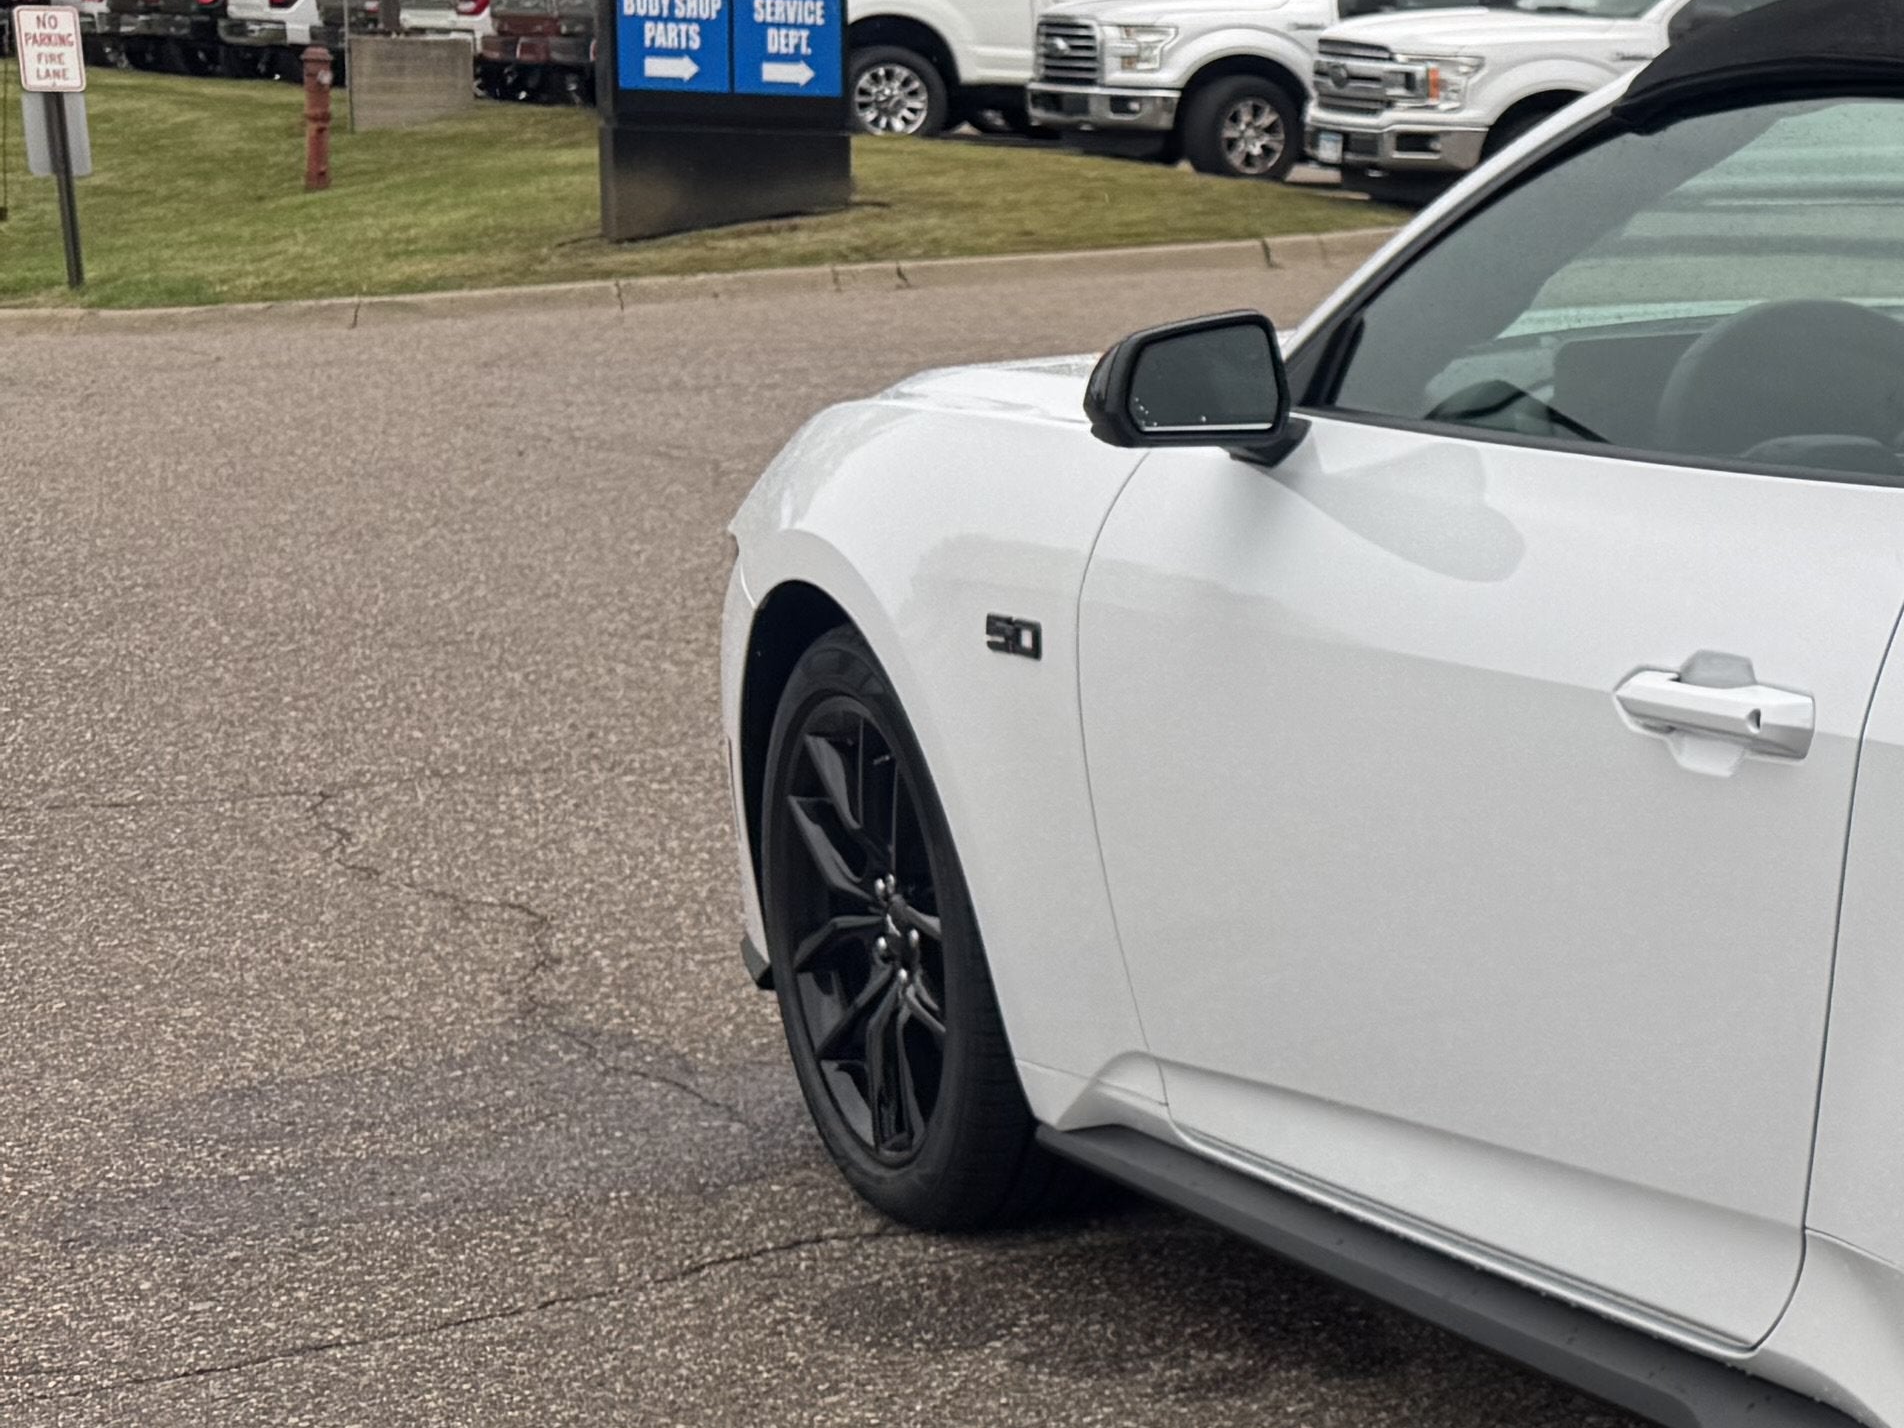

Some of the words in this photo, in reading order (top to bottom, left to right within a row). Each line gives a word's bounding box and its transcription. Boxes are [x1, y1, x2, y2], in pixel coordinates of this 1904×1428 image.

[36, 13, 58, 30] NO
[24, 33, 74, 47] PARKING
[643, 21, 701, 50] PARTS
[767, 28, 812, 55] DEPT.
[37, 52, 65, 65] FIRE
[36, 68, 70, 80] LANE
